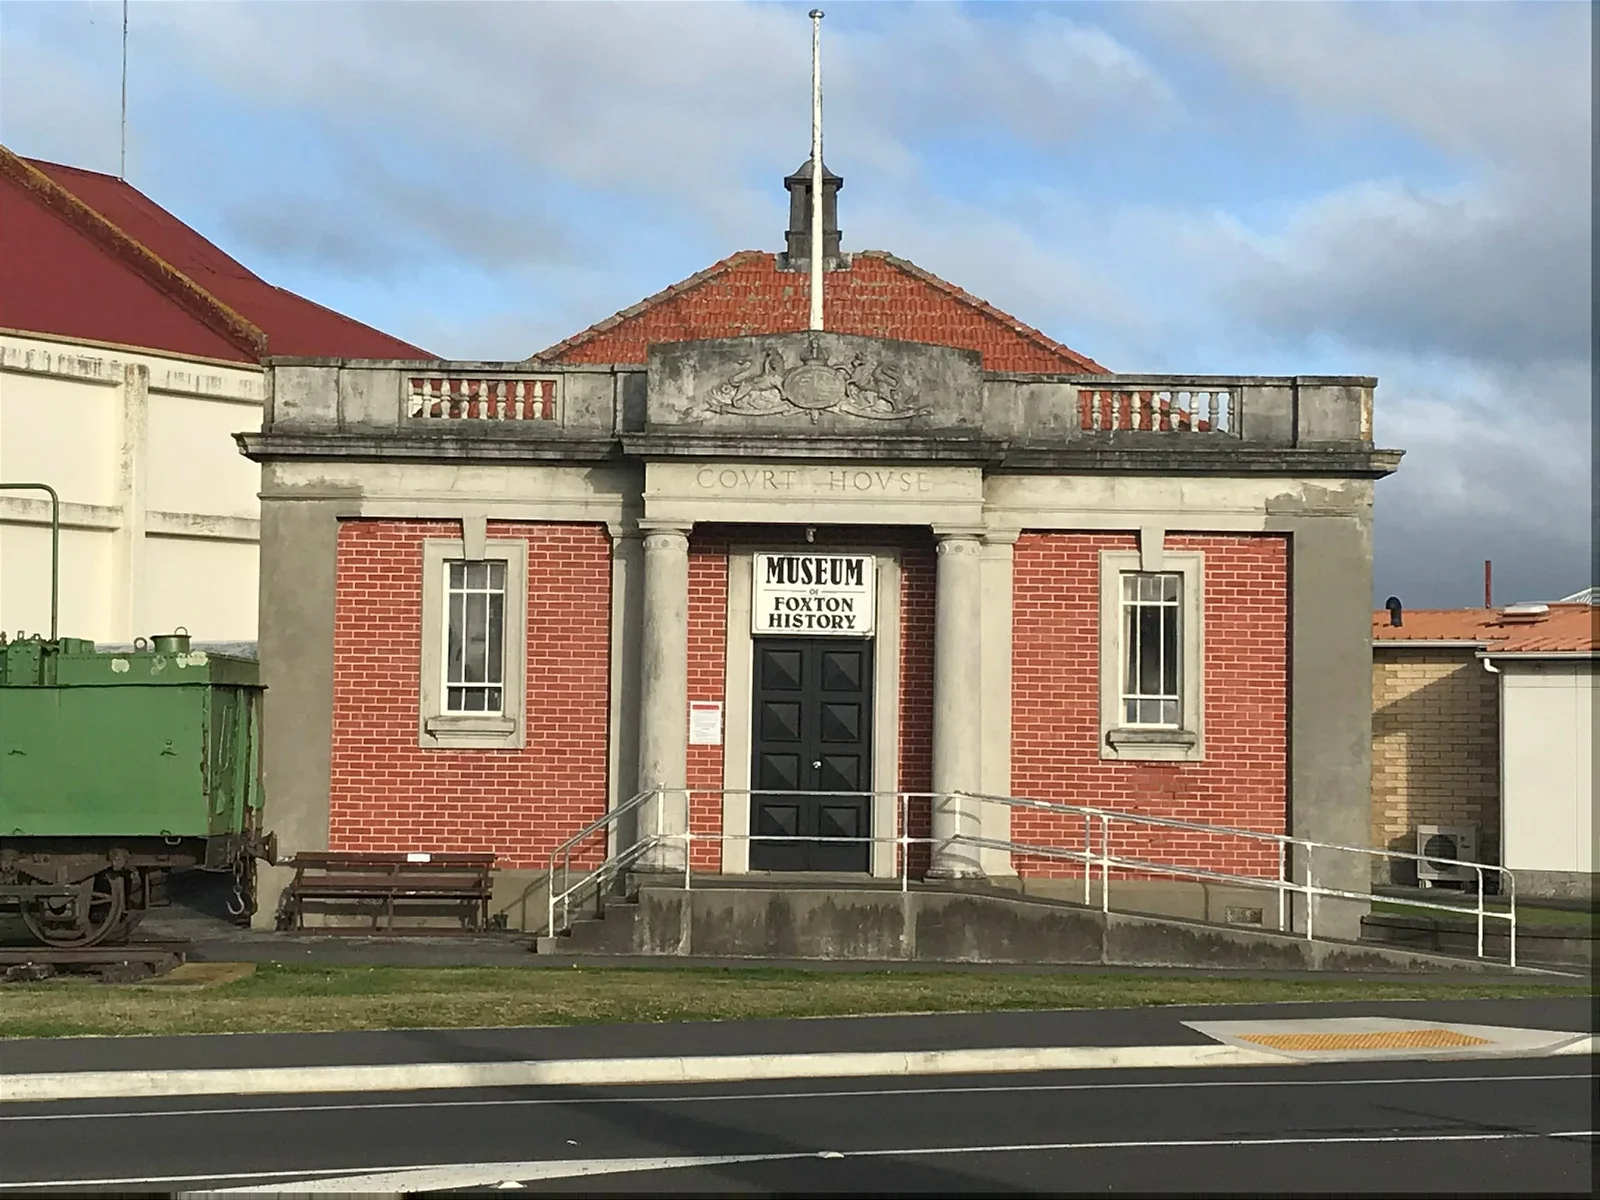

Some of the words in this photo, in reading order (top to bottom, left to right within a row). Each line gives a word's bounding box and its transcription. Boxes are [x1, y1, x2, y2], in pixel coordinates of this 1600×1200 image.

[765, 556, 864, 586] MUSEUM
[774, 596, 854, 612] FOXTON
[768, 613, 857, 629] HISTORY
